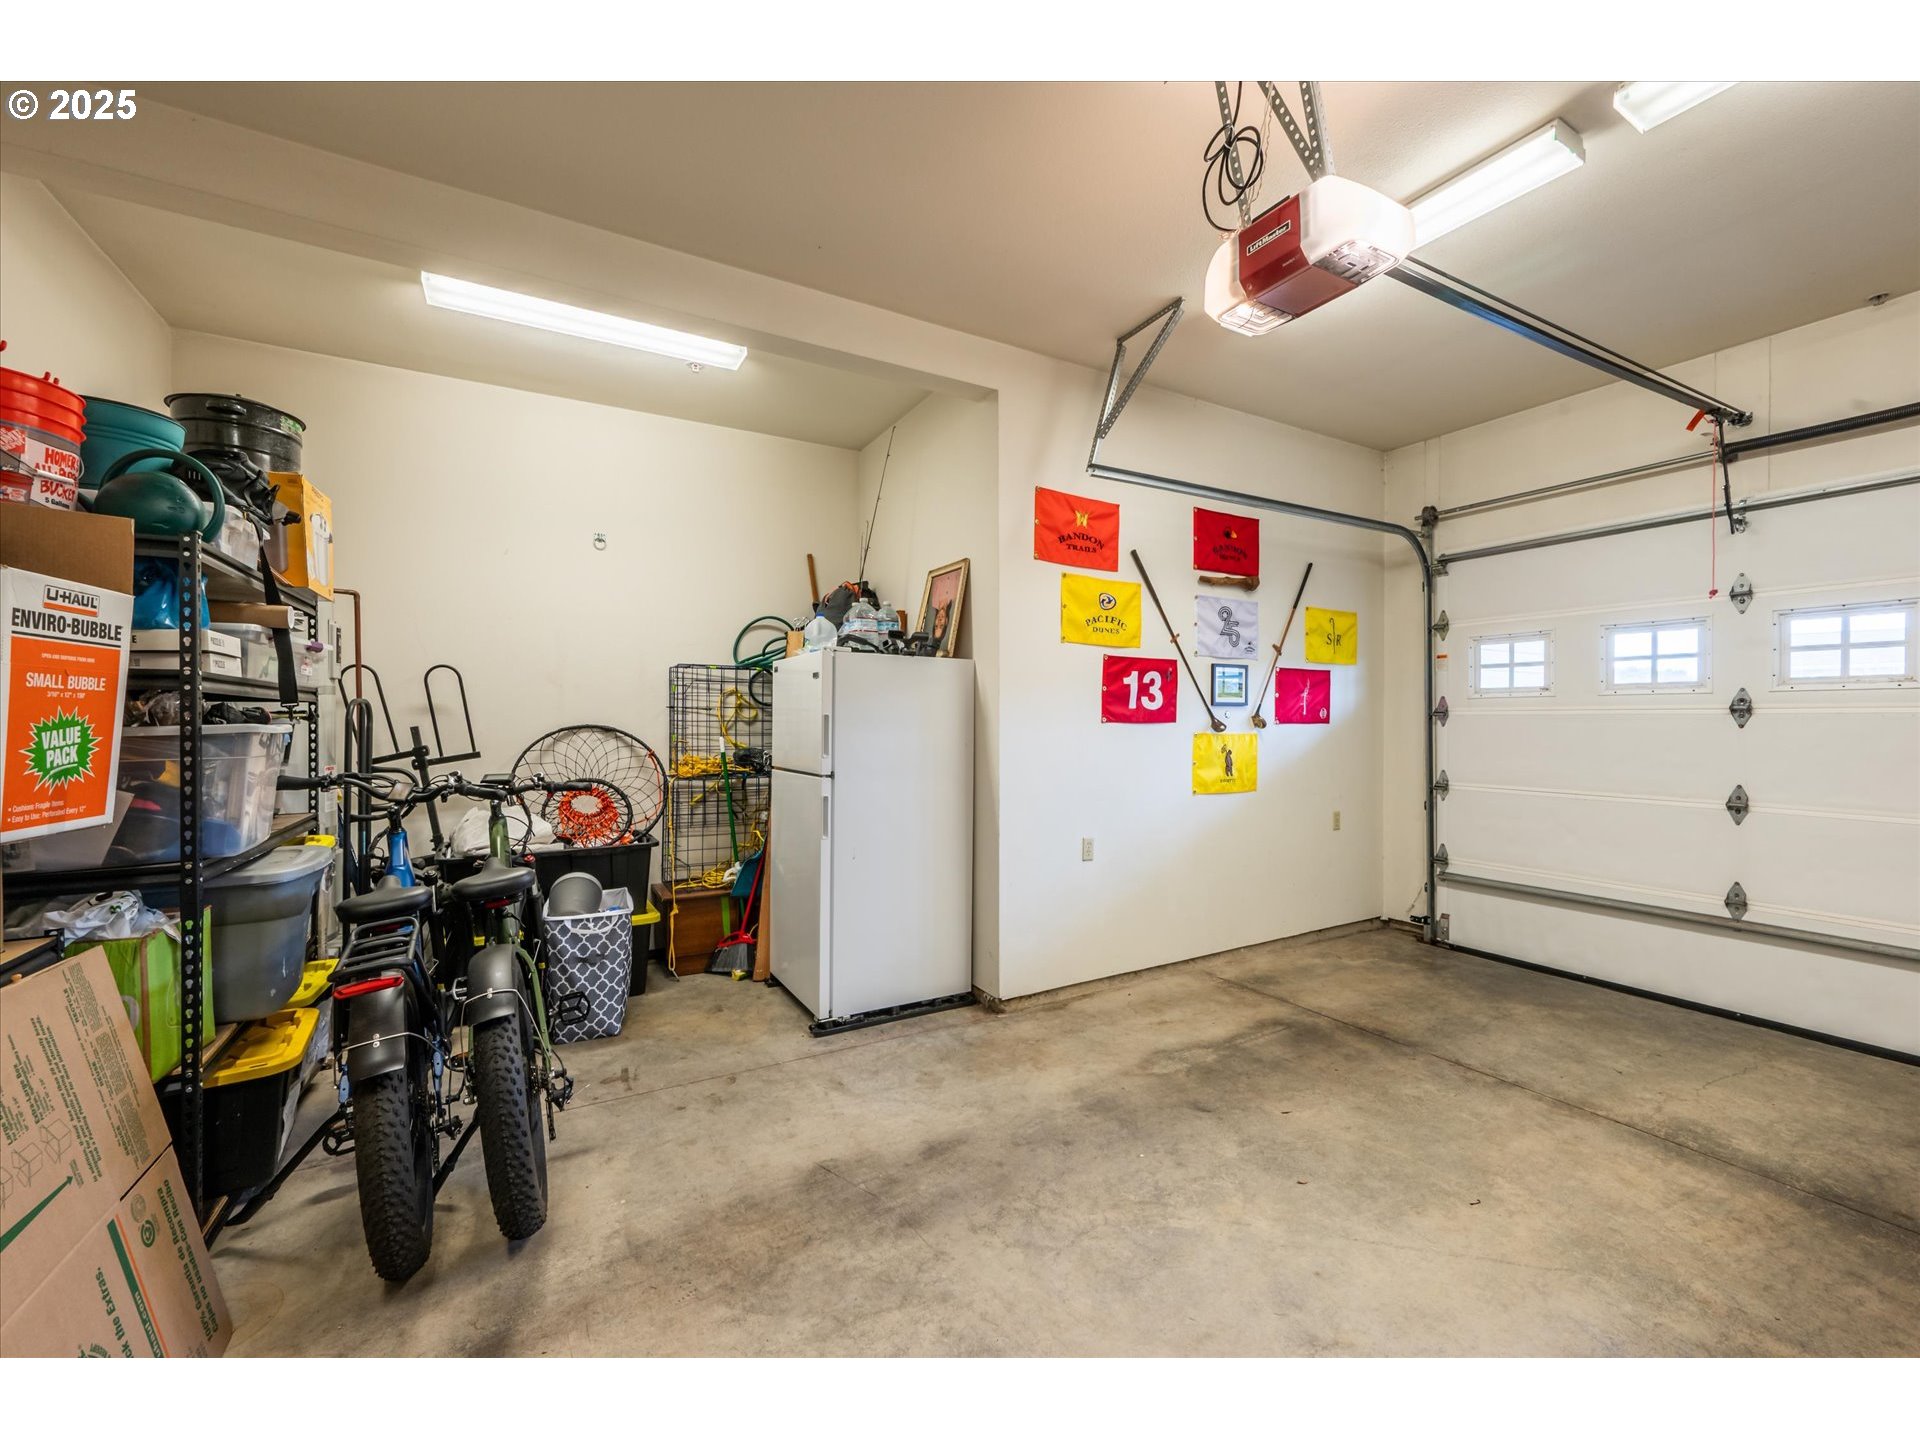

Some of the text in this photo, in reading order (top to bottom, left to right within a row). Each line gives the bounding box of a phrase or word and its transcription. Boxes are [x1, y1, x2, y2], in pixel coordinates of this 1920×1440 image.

[41, 480, 76, 502] BUCKET
[1058, 532, 1104, 550] BANDON
[1066, 543, 1097, 553] TRAILS
[46, 587, 98, 609] U-HAUL
[11, 607, 123, 641] ENVIRO-BUBBLE
[1085, 614, 1127, 631] PACIFIC
[1092, 626, 1120, 634] DUNES
[26, 672, 106, 691] SMALL BUBBLE
[1123, 670, 1163, 710] 13
[41, 726, 82, 750] VALUE
[46, 745, 79, 769] PACK
[63, 988, 79, 1023] RECYCLE
[38, 1037, 52, 1066] specialty
[13, 1063, 22, 1079] Box
[53, 1061, 61, 1073] and
[54, 1076, 62, 1091] than
[19, 1079, 40, 1124] Extra-Large
[60, 1092, 69, 1108] more
[0, 1121, 13, 1145] Large
[163, 1179, 179, 1218] Recibo
[157, 1187, 179, 1244] Recompra
[177, 1245, 185, 1260] de
[95, 1267, 115, 1315] Extras.
[199, 1285, 208, 1300] no
[112, 1316, 125, 1340] the
[199, 1310, 213, 1341] 100%
[205, 1301, 219, 1333] Cajas
